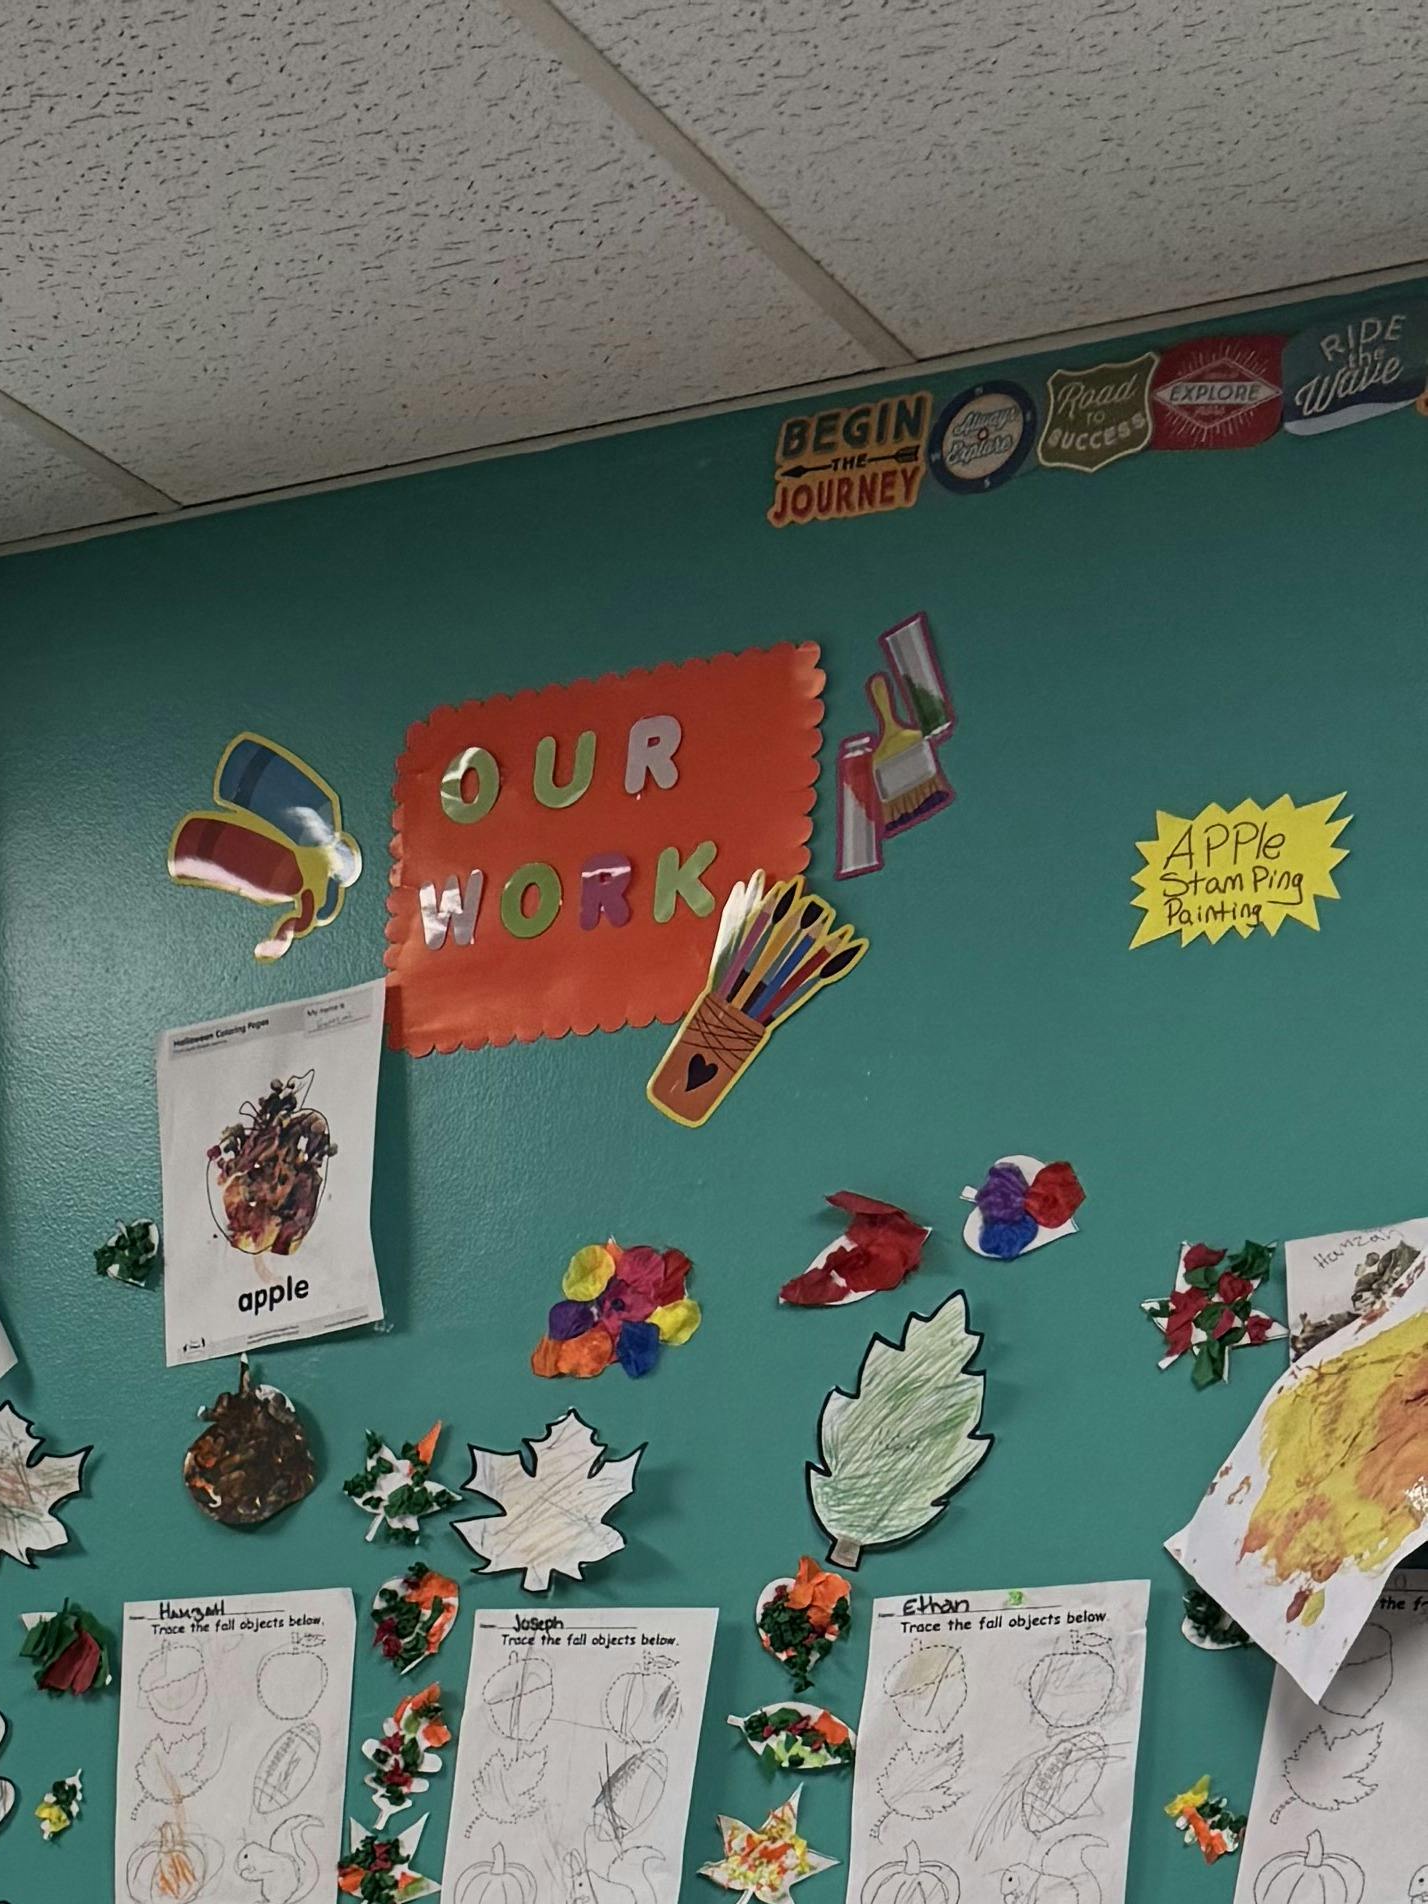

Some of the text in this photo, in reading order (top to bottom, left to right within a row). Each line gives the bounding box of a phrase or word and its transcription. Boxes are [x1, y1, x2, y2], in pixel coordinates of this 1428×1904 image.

[1320, 315, 1407, 362] RIDE
[1348, 345, 1385, 370] the
[1057, 378, 1137, 421] Road
[1169, 383, 1261, 402] EXPLORE
[1294, 357, 1404, 416] Wave
[782, 400, 924, 459] BEGIN
[1048, 413, 1145, 451] SUCCESS
[1086, 411, 1105, 426] TO
[831, 455, 868, 472] THE
[947, 435, 1014, 467] Explore
[773, 466, 921, 522] JOURNEY
[440, 715, 682, 825] OUR
[417, 840, 719, 951] WORK
[1164, 897, 1262, 928] Painting
[238, 1276, 310, 1315] apple
[902, 1595, 970, 1617] Ethan
[1380, 1596, 1406, 1610] the
[152, 1623, 185, 1635] Trace
[191, 1620, 209, 1633] the
[215, 1618, 235, 1633] fall
[240, 1616, 285, 1632] objects
[512, 1613, 564, 1634] Joseph
[900, 1621, 941, 1634] Trace
[948, 1618, 972, 1632] the
[978, 1615, 1003, 1629] fall
[1008, 1613, 1061, 1631] objects
[501, 1633, 535, 1646] Trace
[541, 1633, 561, 1646] the
[567, 1633, 587, 1646] fall
[591, 1633, 636, 1649] objects
